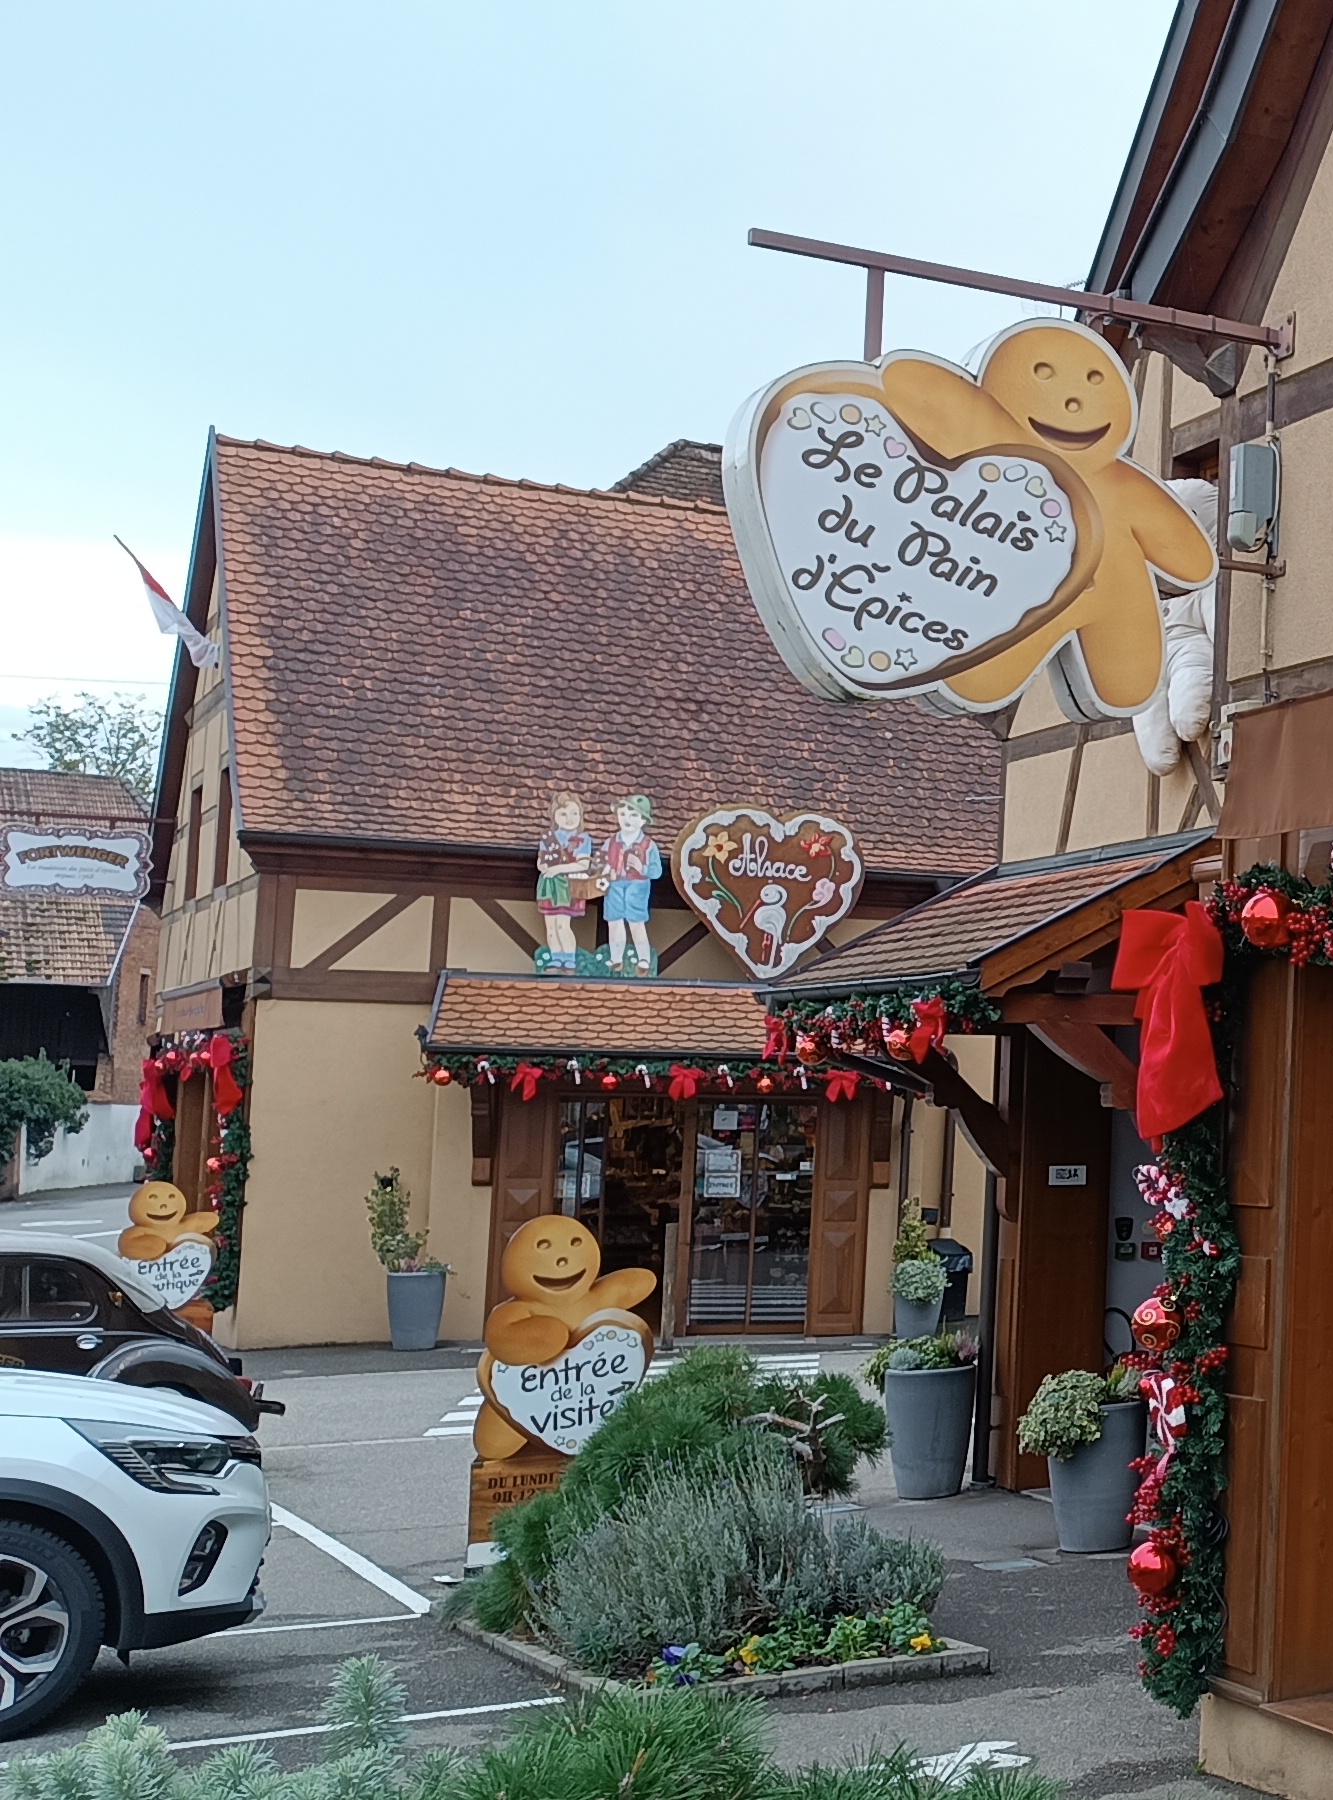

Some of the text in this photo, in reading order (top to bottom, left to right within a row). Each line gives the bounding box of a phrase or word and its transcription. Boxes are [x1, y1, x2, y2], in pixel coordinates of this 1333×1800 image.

[802, 426, 1040, 552] Le Palais
[817, 494, 998, 597] du Pain
[16, 845, 129, 869] FORTWENGER
[729, 832, 813, 882] Alsace
[138, 1255, 201, 1275] Entrée
[155, 1270, 182, 1281] de la
[152, 1278, 200, 1294] utique
[520, 1351, 629, 1393] Entrée
[551, 1382, 596, 1402] de la
[530, 1396, 615, 1433] visite
[488, 1472, 556, 1489] DU LUNDI
